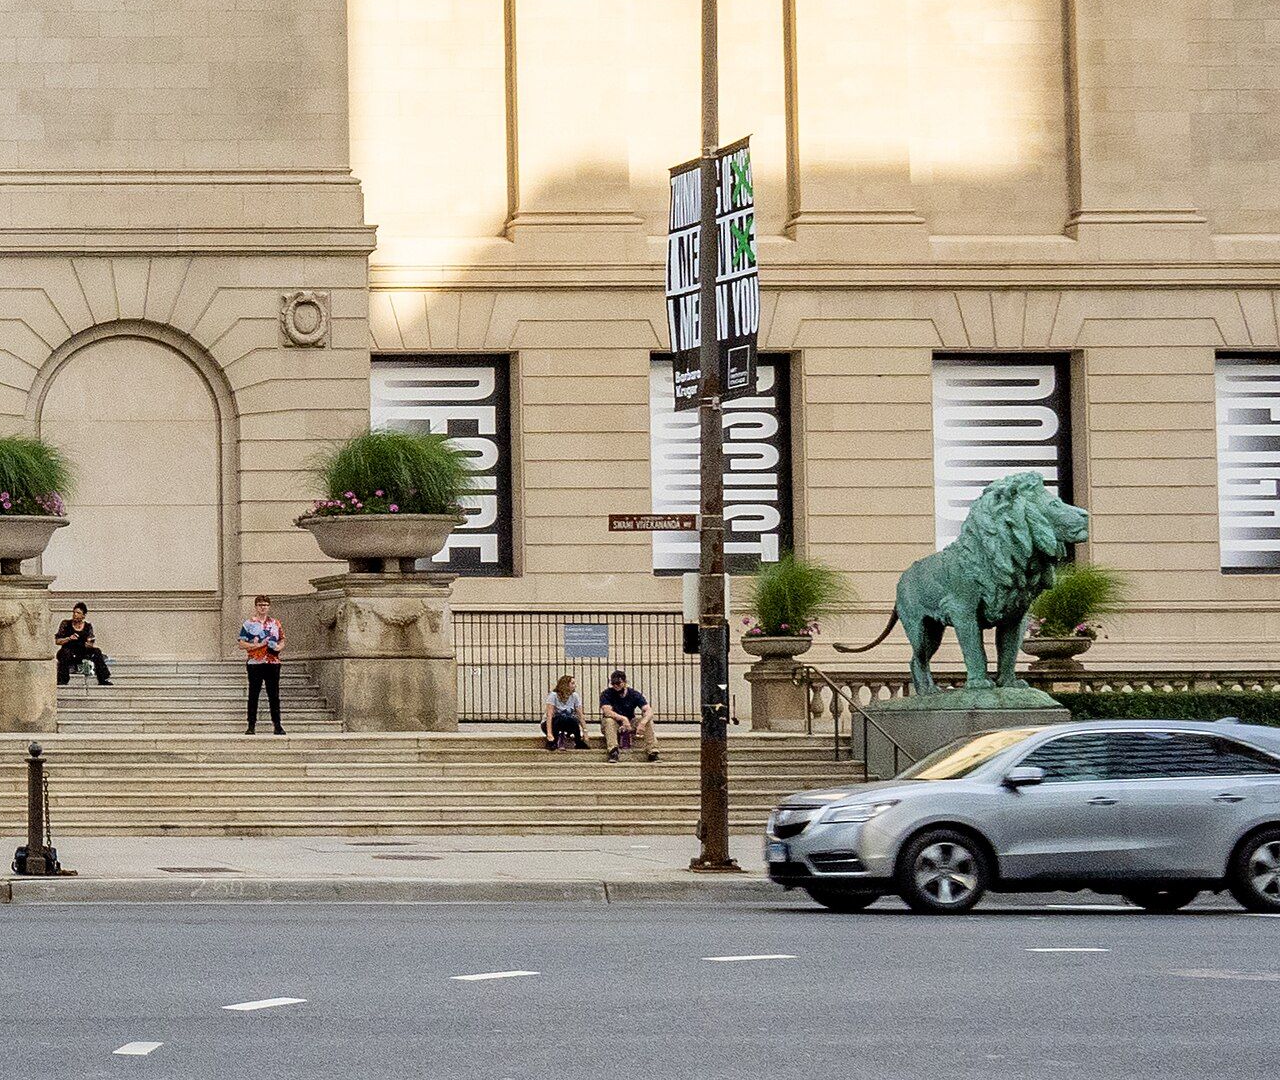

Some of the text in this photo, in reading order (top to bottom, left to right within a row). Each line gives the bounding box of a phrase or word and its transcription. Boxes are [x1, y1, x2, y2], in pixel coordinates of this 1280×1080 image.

[677, 220, 726, 289] MEN
[679, 283, 729, 351] MEN
[732, 275, 759, 338] YOU
[935, 366, 1059, 552] DOU
